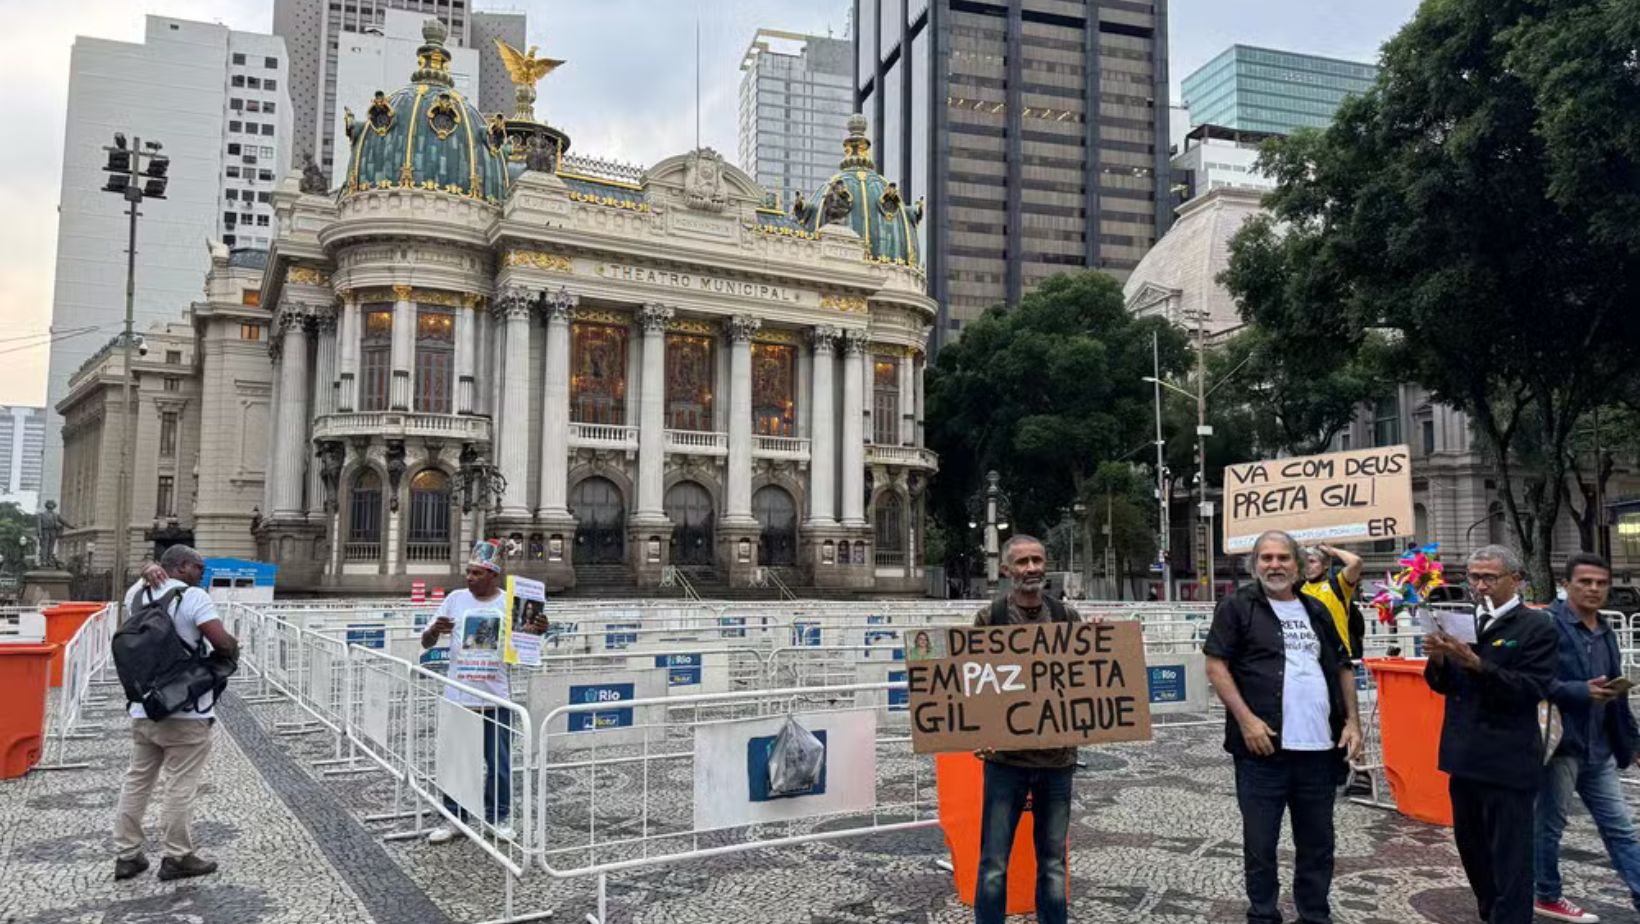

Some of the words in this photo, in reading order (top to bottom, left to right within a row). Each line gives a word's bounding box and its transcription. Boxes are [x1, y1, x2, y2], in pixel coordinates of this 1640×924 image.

[610, 264, 690, 288] THEATRO
[700, 277, 790, 301] MUNICIPAL
[1281, 458, 1334, 478] COM
[1345, 453, 1406, 476] DEUS
[1233, 484, 1308, 519] PRETA
[1368, 516, 1397, 536] ER
[949, 622, 1115, 656] DESCANSE
[1280, 620, 1308, 630] RETA
[962, 661, 1026, 697] PAZ
[1031, 659, 1126, 693] PRETA
[599, 689, 621, 701] Rio
